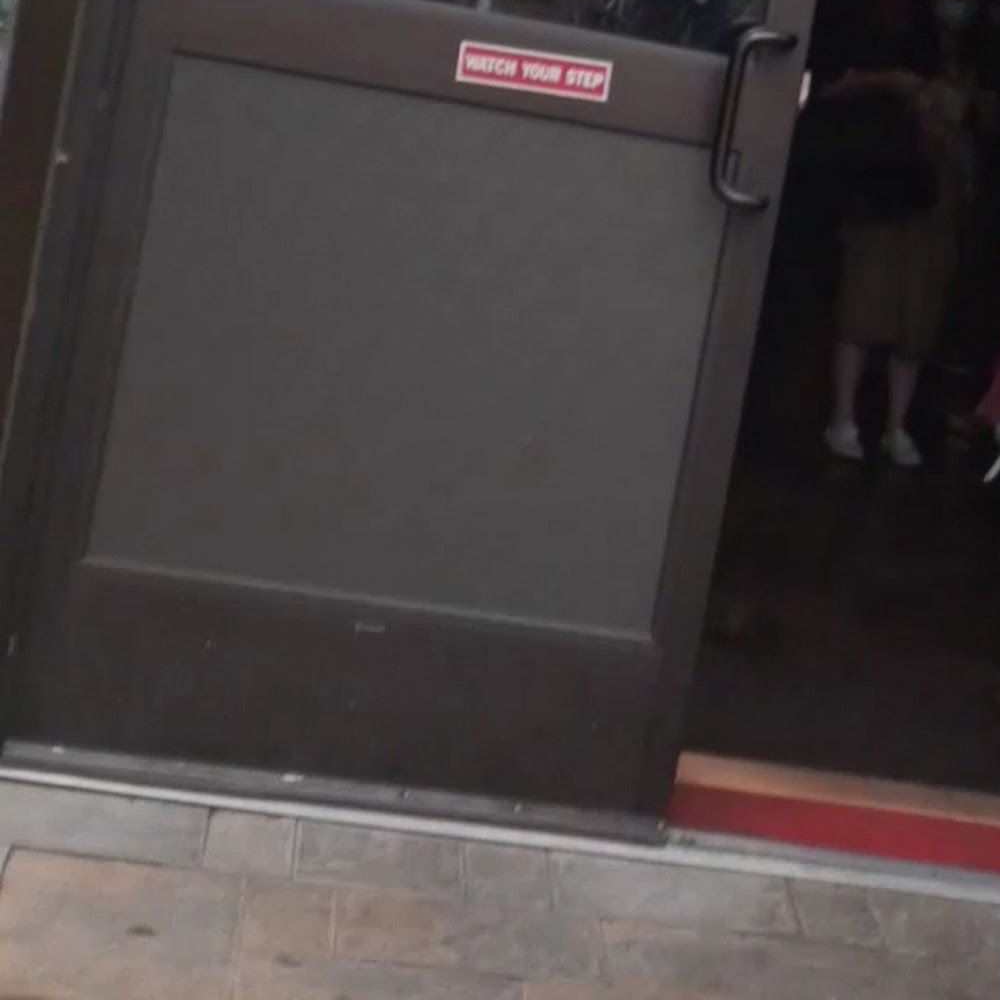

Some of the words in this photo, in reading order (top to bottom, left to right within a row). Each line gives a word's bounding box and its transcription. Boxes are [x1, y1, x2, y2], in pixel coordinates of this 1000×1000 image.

[464, 54, 518, 77] WATCH
[521, 62, 562, 83] YOUR
[565, 67, 605, 89] STEP
